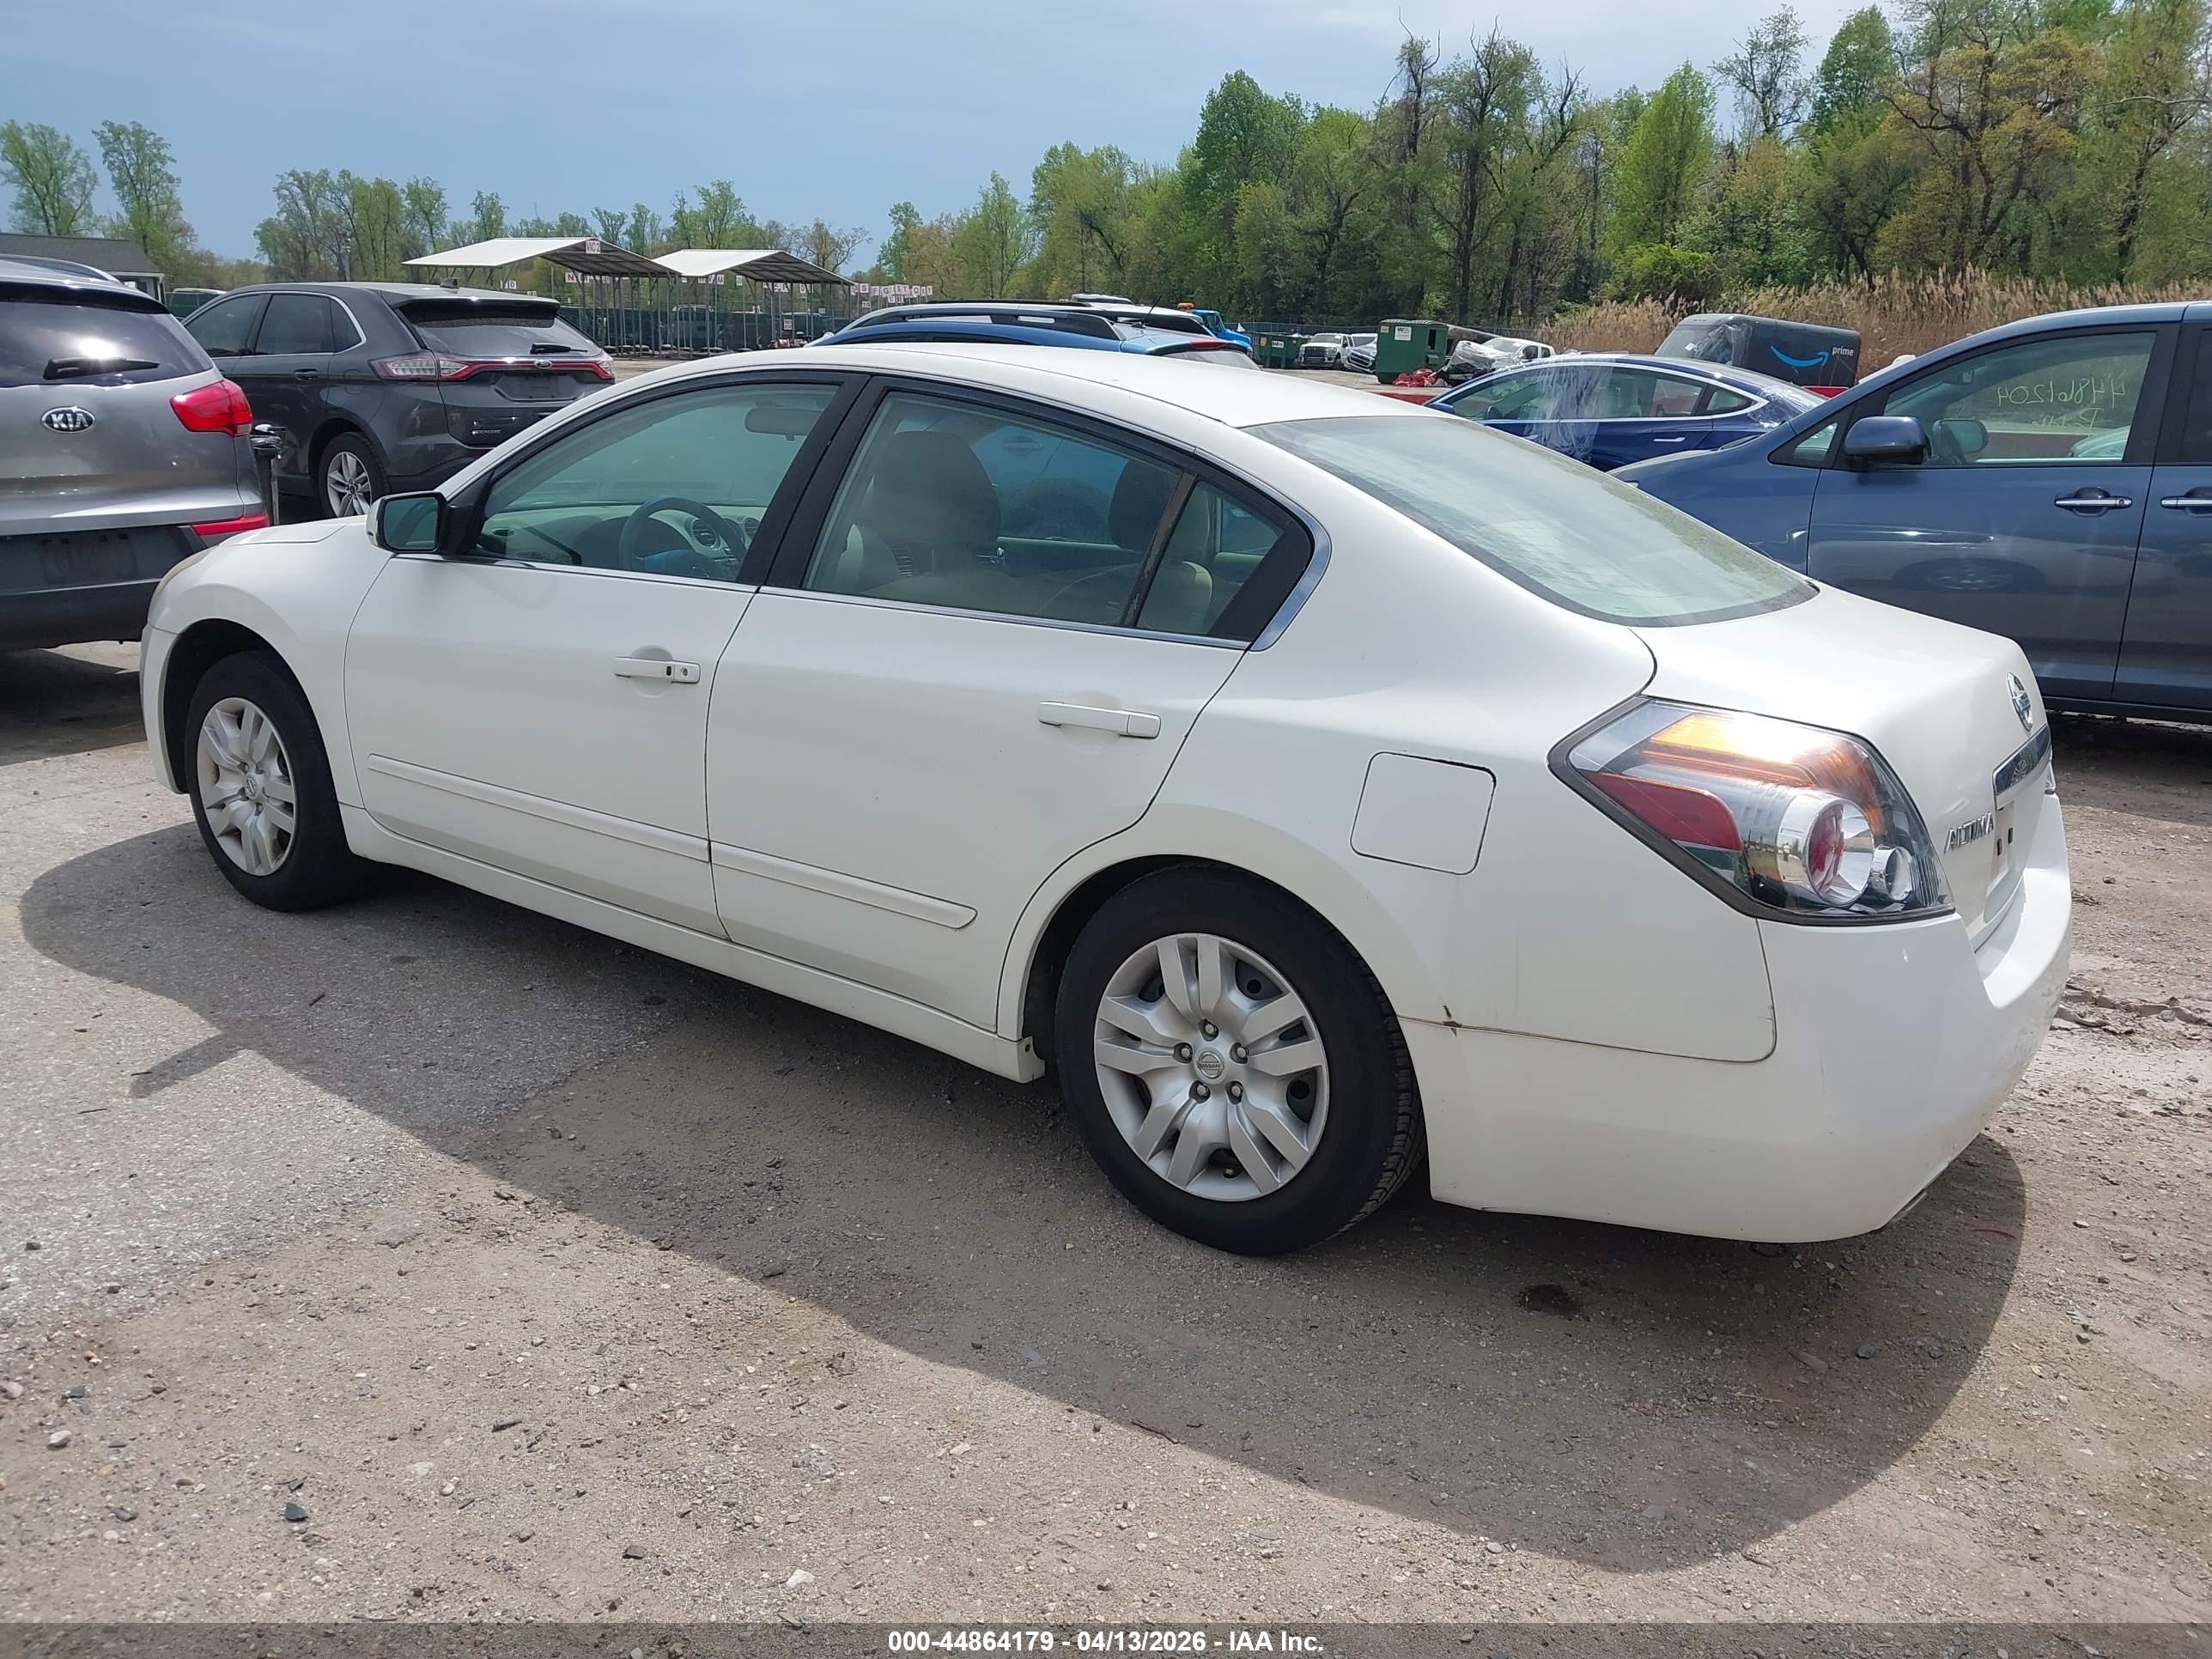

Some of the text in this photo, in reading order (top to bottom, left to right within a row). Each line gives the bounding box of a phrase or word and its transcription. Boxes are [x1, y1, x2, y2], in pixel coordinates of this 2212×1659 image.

[1832, 345, 1855, 356] prime
[51, 413, 88, 428] KIA
[1943, 812, 1995, 853] ALTIMA
